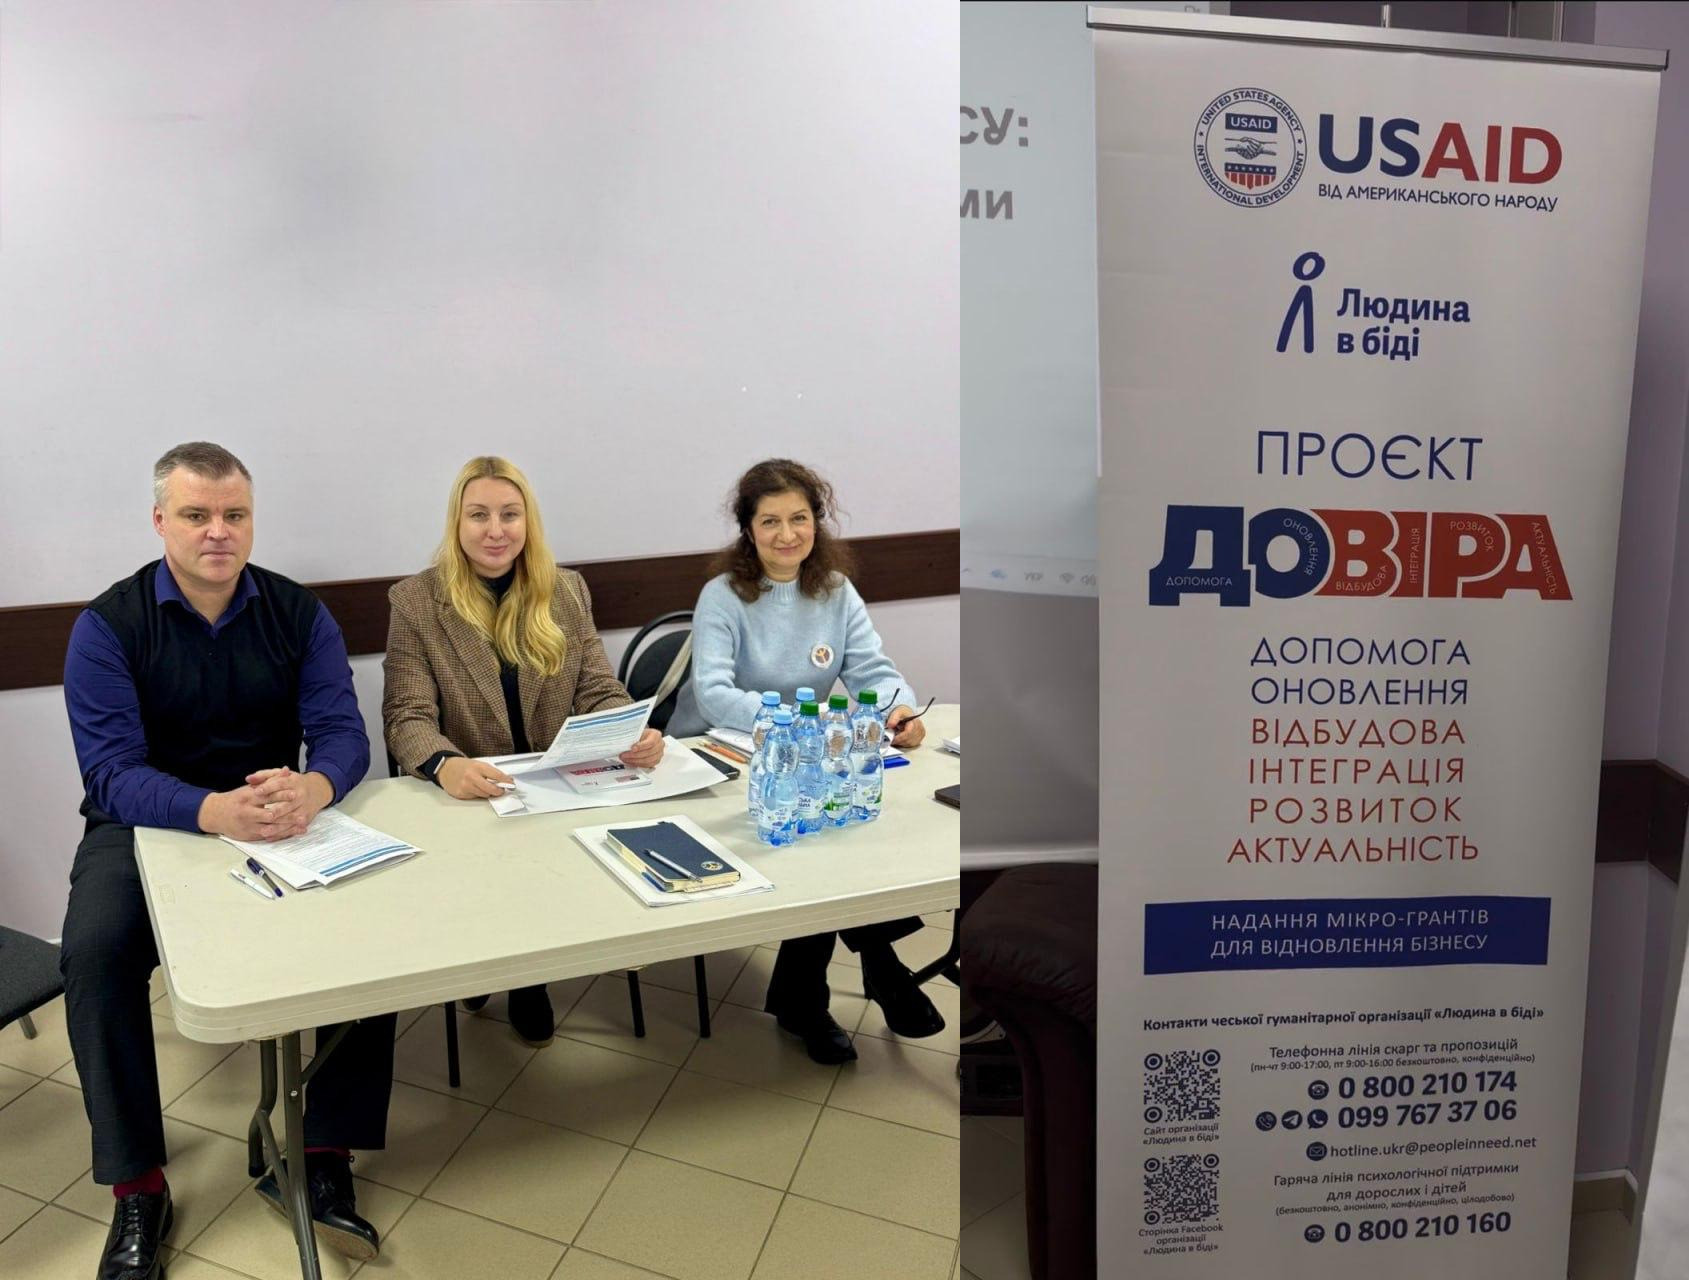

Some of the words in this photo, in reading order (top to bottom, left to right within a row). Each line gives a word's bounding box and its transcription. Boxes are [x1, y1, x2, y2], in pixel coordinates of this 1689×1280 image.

[1201, 94, 1232, 126] UNITED
[1233, 90, 1269, 102] STATES
[1269, 97, 1301, 132] AGENCY
[1230, 116, 1272, 129] USAID
[1317, 113, 1563, 185] USAID
[1196, 144, 1254, 205] INTERNATIONAL
[1255, 151, 1304, 205] DEVELOPMENT
[1318, 183, 1343, 201] ВІД
[1346, 185, 1492, 207] АМЕРИКАНСЬКОГО
[1495, 194, 1558, 213] НАРОДУ
[1337, 288, 1470, 323] Людина
[1337, 333, 1354, 354] в
[1362, 328, 1420, 360] біді
[1257, 430, 1483, 481] ПРОЄКТ
[1283, 518, 1319, 576] ОНОВЛЕННЯ
[1450, 520, 1495, 552] РОЗВИТОК
[1149, 504, 1574, 607] ДОВІРА
[1410, 527, 1421, 584] ІНТЕГРАЦІЯ
[1531, 521, 1557, 594] АКТУАЛЬНІСТЬ
[1166, 576, 1233, 587] ДОПОМОГА
[1335, 564, 1387, 592] ВІДБУДОВА
[1250, 637, 1471, 667] ДОПОМОГА
[1251, 676, 1469, 706] ОНОВЛЕННЯ
[1251, 718, 1466, 748] ВІДБУДОВА
[1249, 757, 1465, 788] ІНТЕГРАЦІЯ
[1250, 796, 1462, 825] РОЗВИТОК
[1227, 835, 1480, 864] АКТУАЛЬНІСТЬ
[1211, 912, 1318, 933] НАДАННЯ
[1327, 909, 1490, 929] МІКРО-ГРАНТІВ
[1210, 940, 1254, 959] ДЛЯ
[1261, 936, 1404, 957] ВІДНОВЛЕННЯ
[1411, 934, 1488, 953] БІЗНЕСУ
[1143, 1015, 1207, 1031] Контакти
[1212, 1013, 1263, 1027] чеської
[1267, 1010, 1354, 1027] гуманітарної
[1358, 1008, 1431, 1024] організації
[1435, 1007, 1496, 1020] «Людина
[1500, 1009, 1507, 1018] в
[1510, 1004, 1544, 1019] біді»
[1269, 1045, 1344, 1059] Телефонна
[1348, 1043, 1380, 1056] лінія
[1384, 1043, 1420, 1056] скарг
[1424, 1043, 1436, 1053] та
[1441, 1038, 1518, 1052] пропозицій
[1346, 1059, 1393, 1068] 9:00-16:00
[1338, 1077, 1355, 1099] 0
[1363, 1075, 1414, 1099] 800
[1422, 1072, 1467, 1096] 210
[1475, 1071, 1517, 1092] 174
[1338, 1105, 1388, 1128] 099
[1396, 1103, 1442, 1126] 767
[1447, 1100, 1478, 1123] 37
[1484, 1099, 1517, 1121] 06
[1143, 1126, 1165, 1135] Сайт
[1168, 1122, 1219, 1134] організації
[1330, 1136, 1537, 1158] hotline.ukr@peopleinneed.net
[1274, 1174, 1318, 1188] Гаряча
[1322, 1172, 1353, 1184] лінія
[1357, 1166, 1447, 1182] психологічної
[1451, 1163, 1519, 1178] підтримки
[1326, 1190, 1351, 1202] для
[1355, 1186, 1421, 1201] дорослих
[1431, 1181, 1467, 1196] дітей
[1138, 1227, 1179, 1237] Сторінка
[1181, 1223, 1224, 1234] Facebook
[1156, 1234, 1207, 1246] організації
[1335, 1220, 1351, 1243] 0
[1357, 1218, 1408, 1242] 800
[1415, 1214, 1460, 1239] 210
[1466, 1211, 1512, 1235] 160
